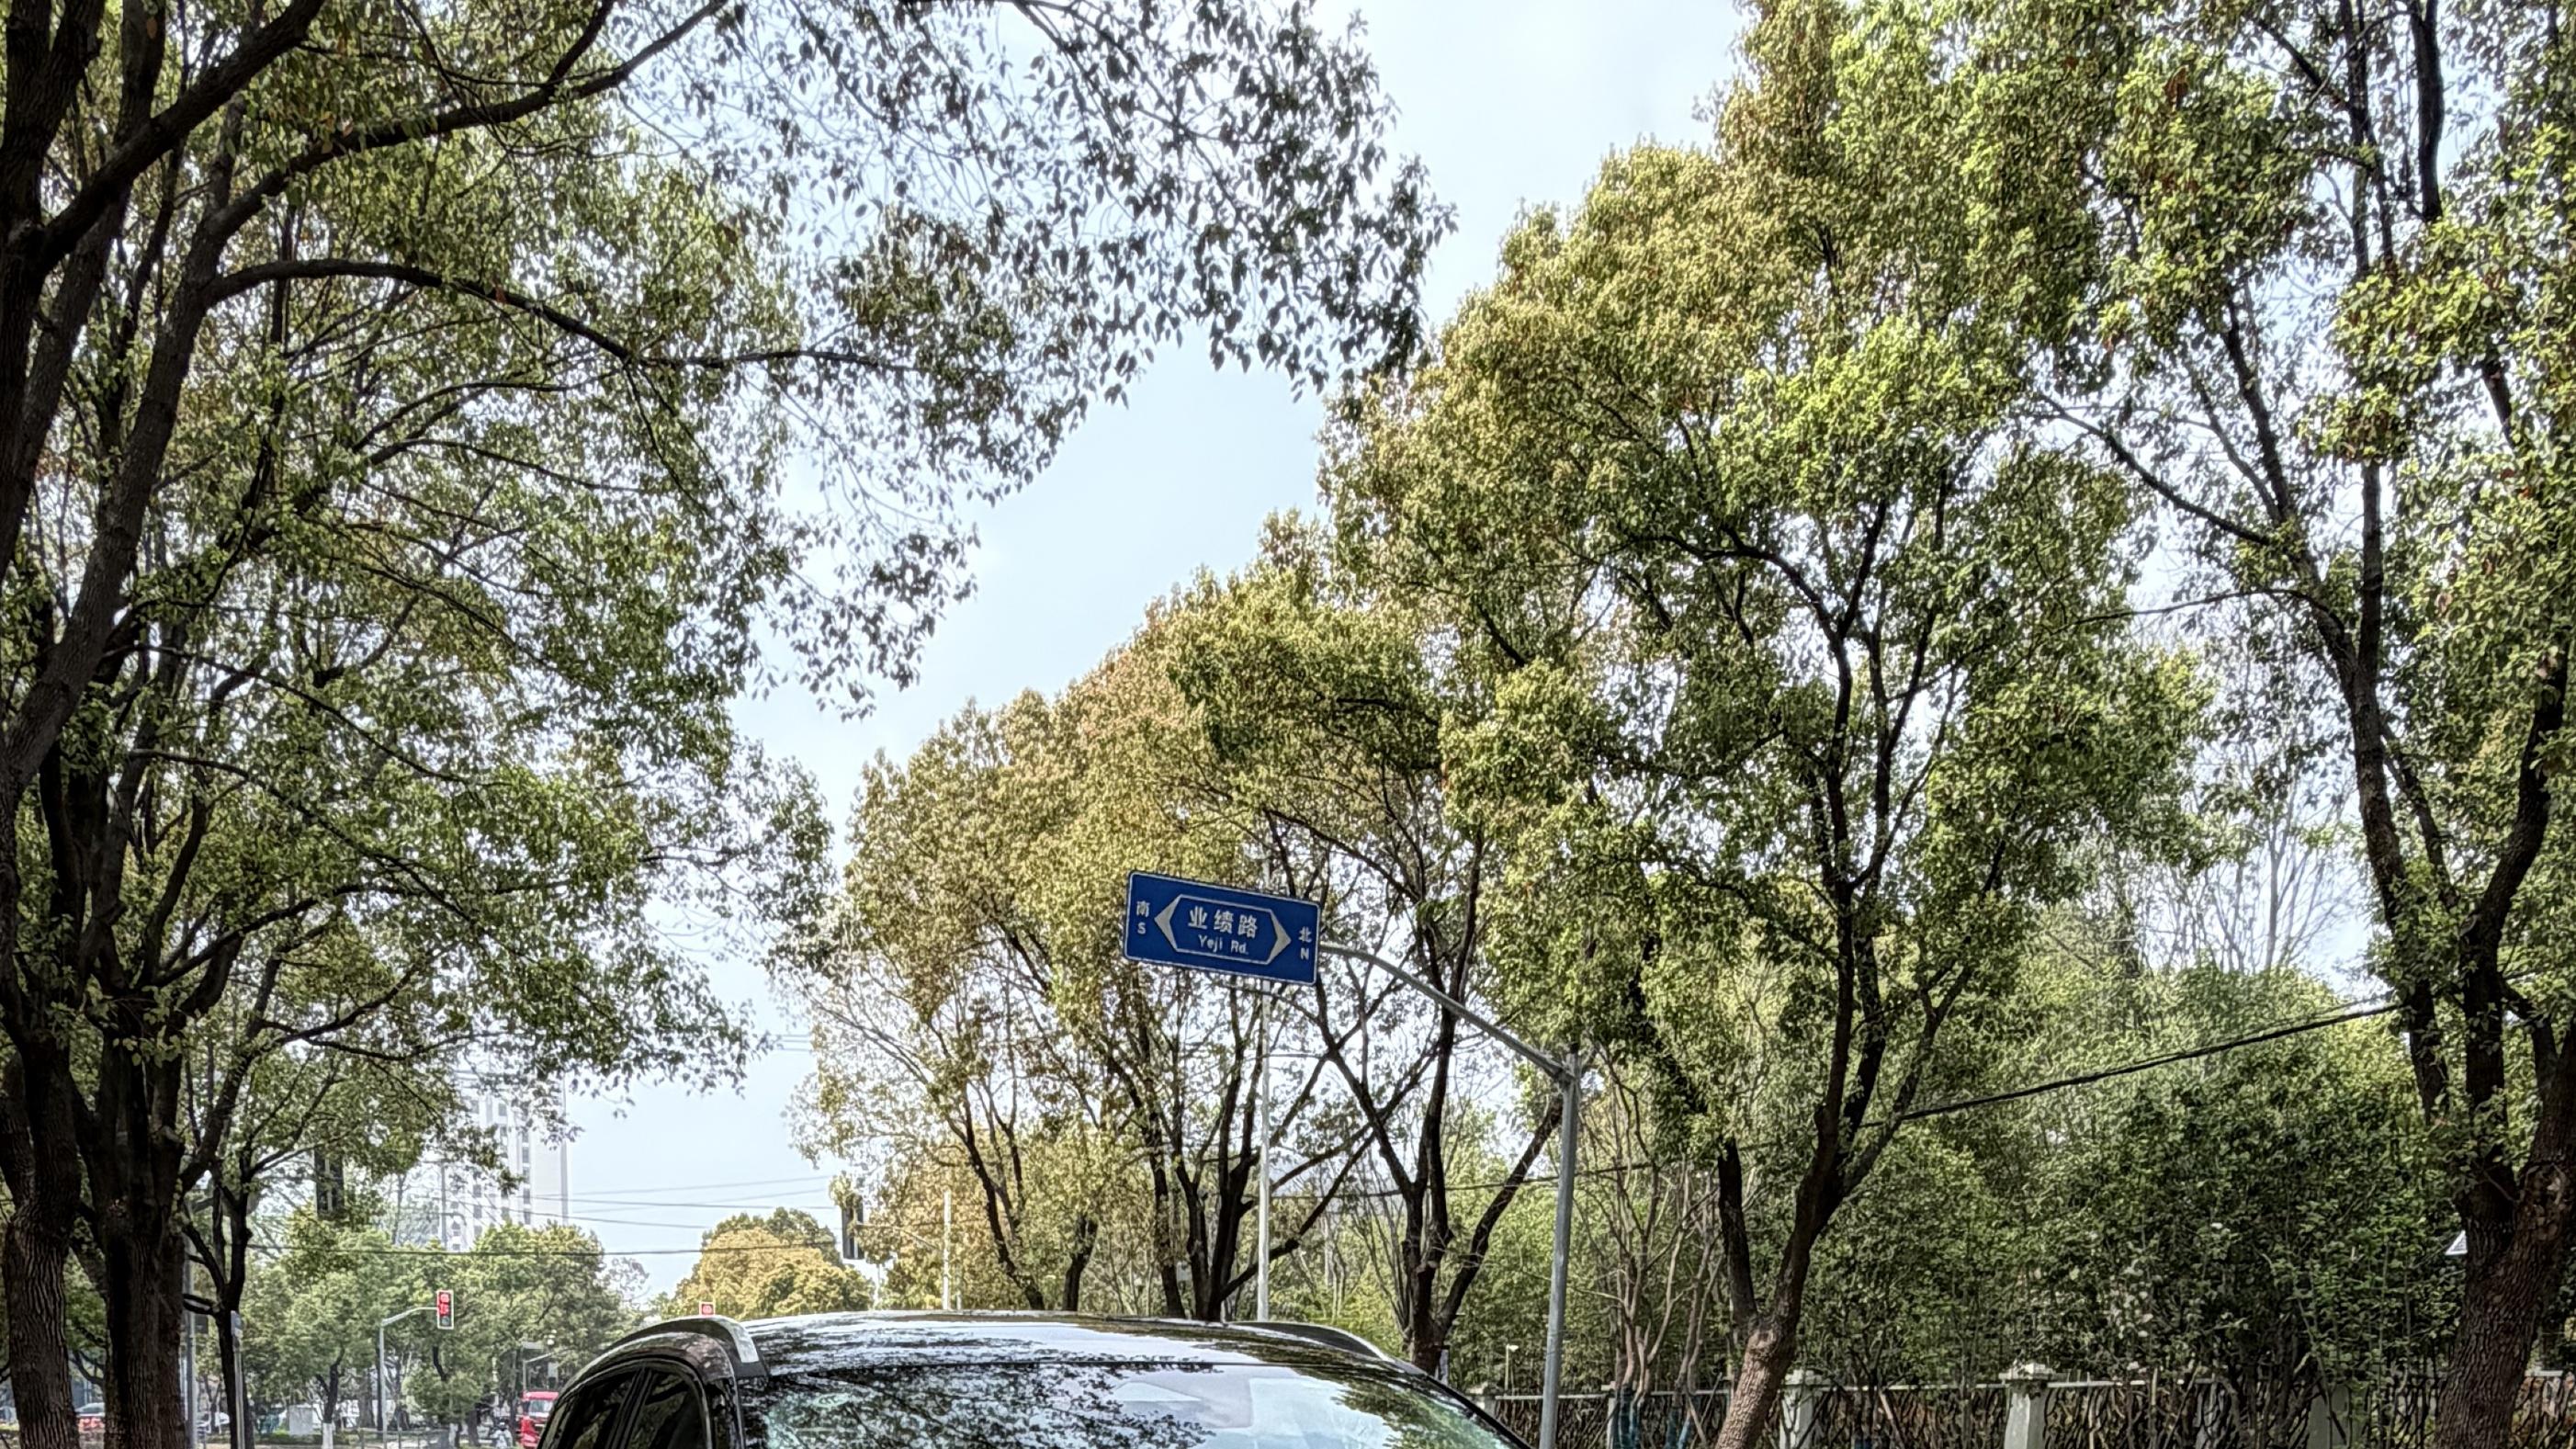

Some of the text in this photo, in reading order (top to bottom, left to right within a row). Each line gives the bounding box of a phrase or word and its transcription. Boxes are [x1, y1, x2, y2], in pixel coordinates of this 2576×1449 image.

[1136, 900, 1149, 917] 南
[1137, 923, 1147, 934] S
[1188, 906, 1258, 938] 业绩路
[1299, 926, 1312, 943] 北
[1198, 934, 1223, 953] Yeji
[1300, 947, 1309, 960] N
